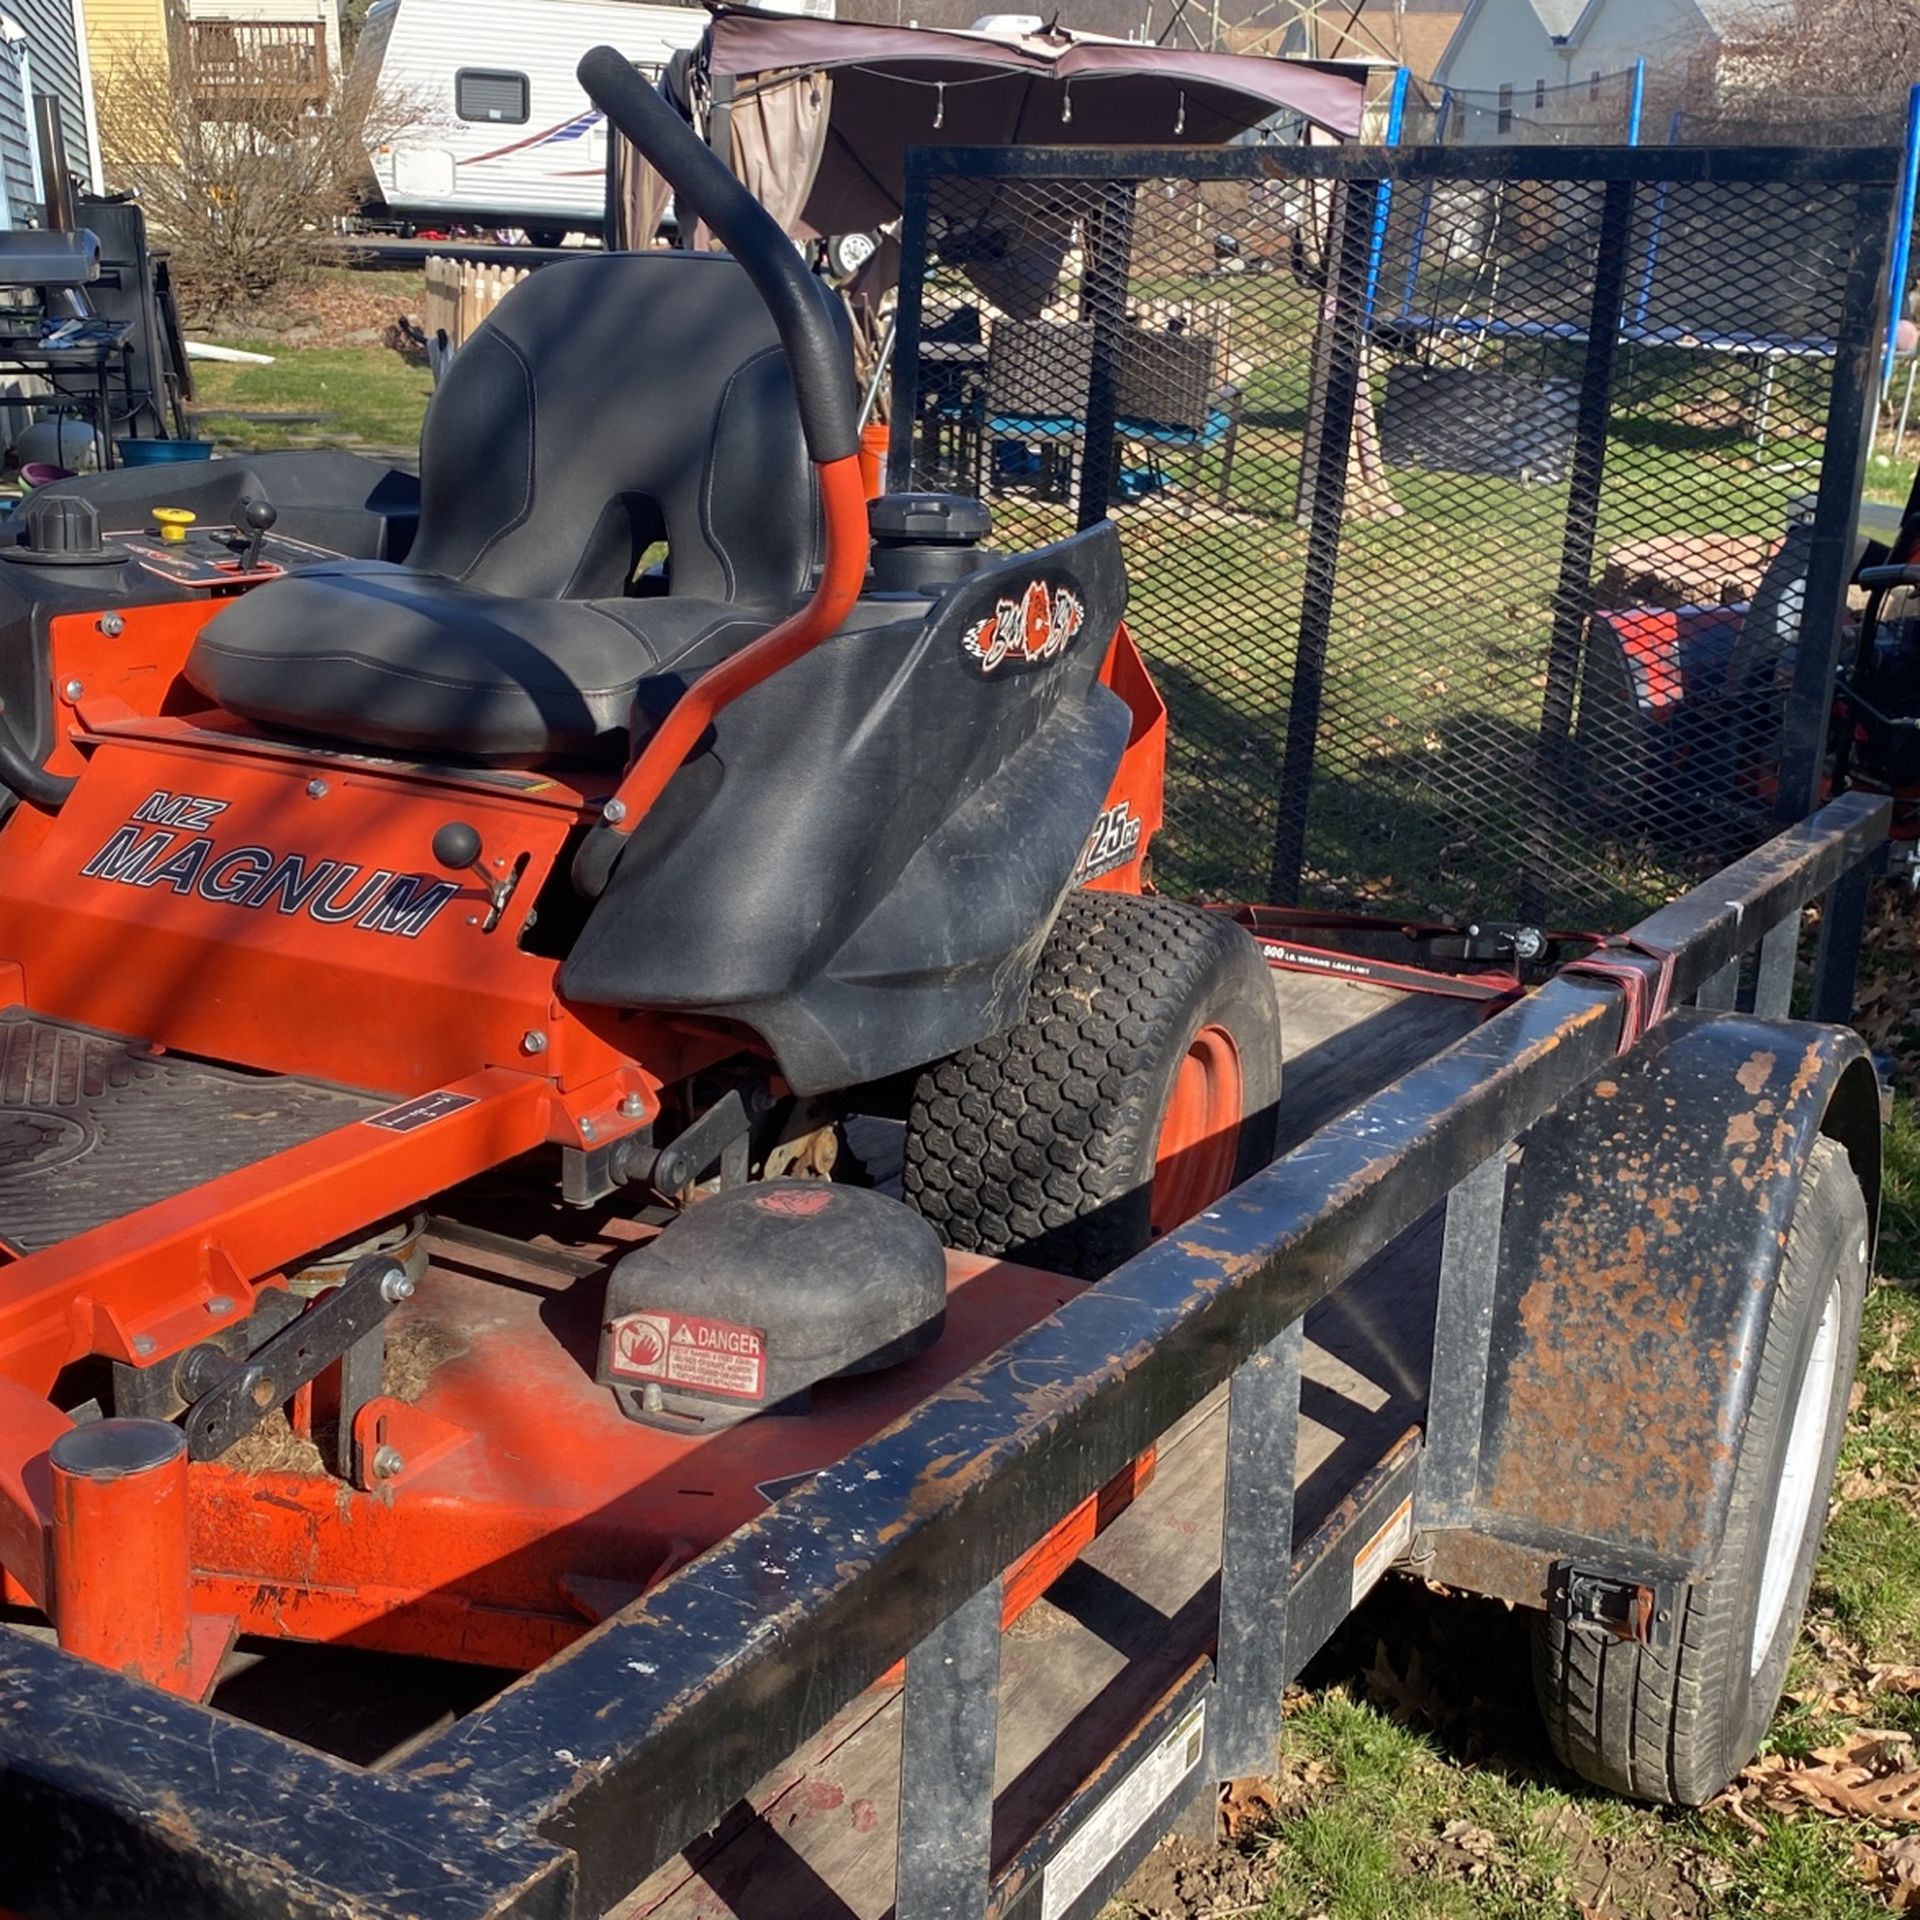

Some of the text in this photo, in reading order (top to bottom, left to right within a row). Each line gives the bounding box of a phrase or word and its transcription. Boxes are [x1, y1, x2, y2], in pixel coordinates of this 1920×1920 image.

[132, 789, 231, 832] MZ
[80, 824, 462, 939] MAGNUM
[698, 1326, 760, 1355] DANGER
